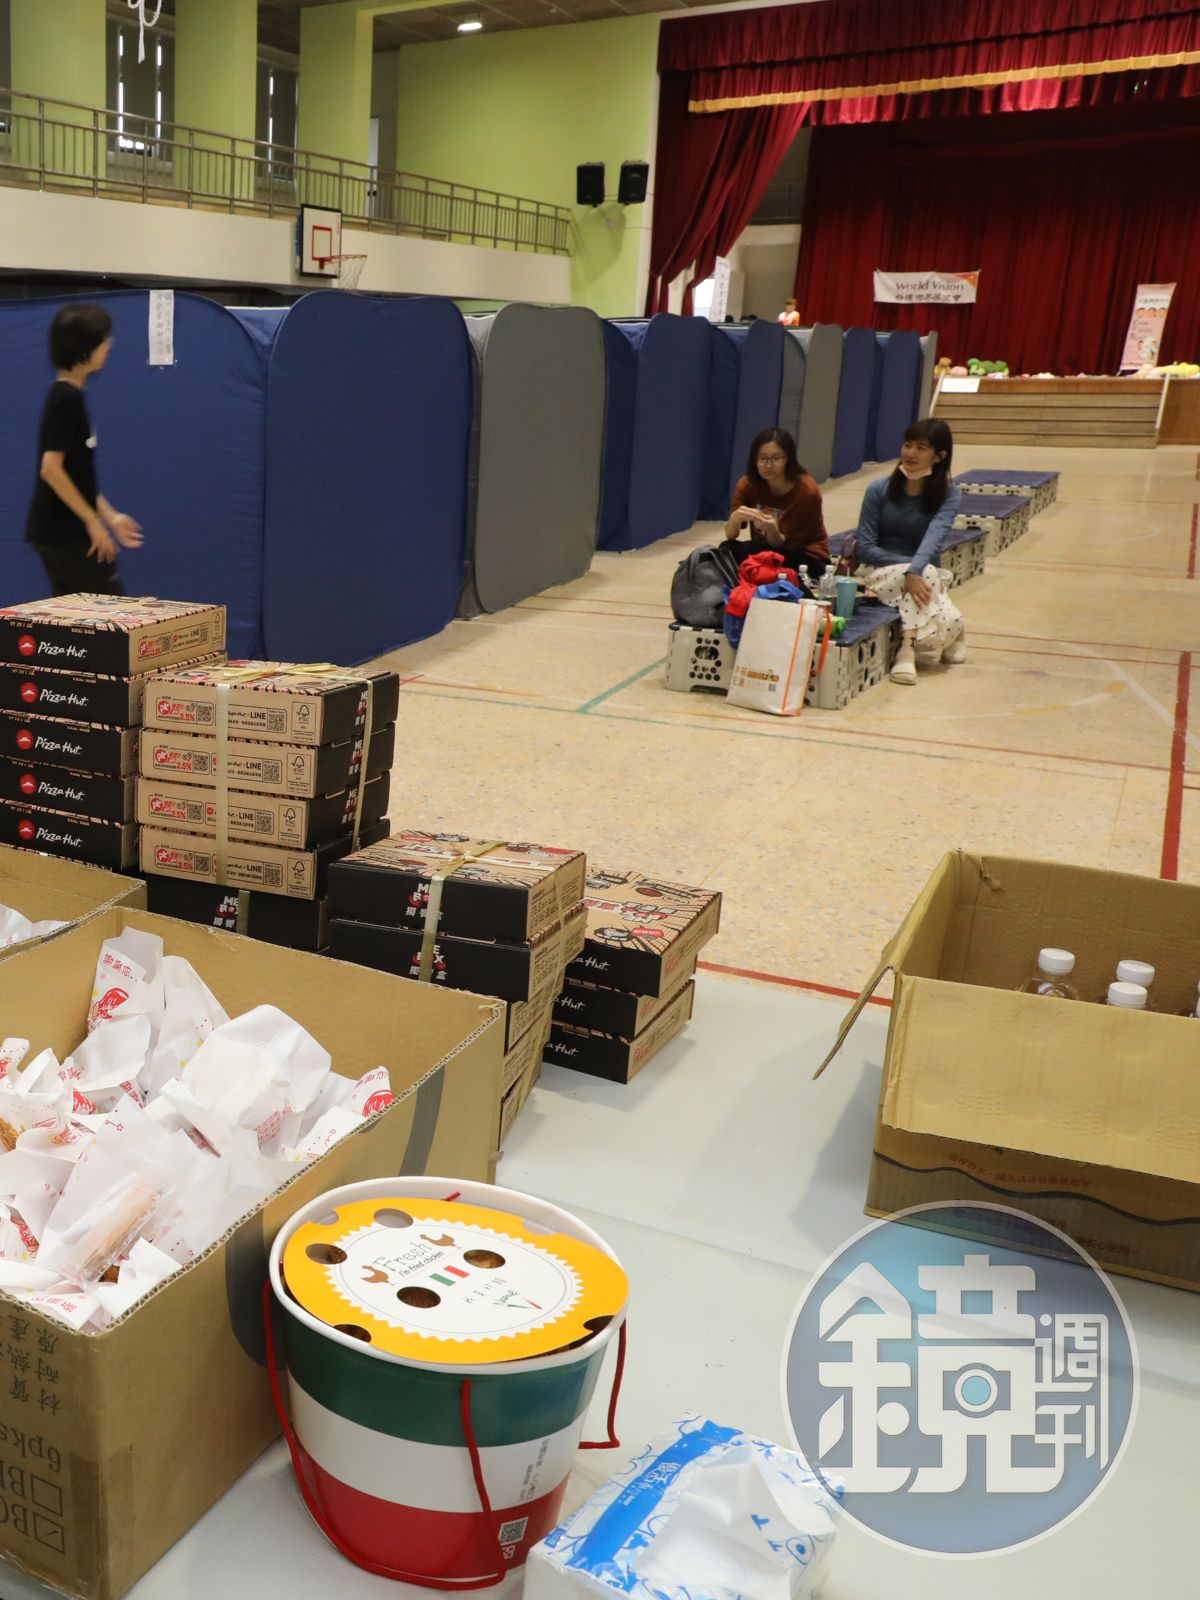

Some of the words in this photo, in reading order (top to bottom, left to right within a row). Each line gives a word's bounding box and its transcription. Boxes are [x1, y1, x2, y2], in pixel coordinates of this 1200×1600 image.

[896, 280, 929, 291] World
[931, 280, 965, 291] Vision
[38, 641, 65, 655] Pizza
[66, 645, 88, 658] Hut
[40, 688, 66, 703] Pizza
[67, 693, 88, 707] Hut
[250, 711, 266, 720] LINE
[35, 736, 61, 750] Pizza
[61, 741, 83, 755] Hut
[246, 761, 262, 771] LINE
[38, 781, 63, 796] Pizza
[64, 787, 85, 801] Hut
[238, 812, 254, 821] LINE
[36, 827, 62, 842] Pizza
[62, 833, 83, 847] Hut
[247, 864, 263, 873] LINE
[373, 1242, 433, 1272] Fresh
[410, 1261, 425, 1273] fried
[424, 1250, 445, 1265] chicken
